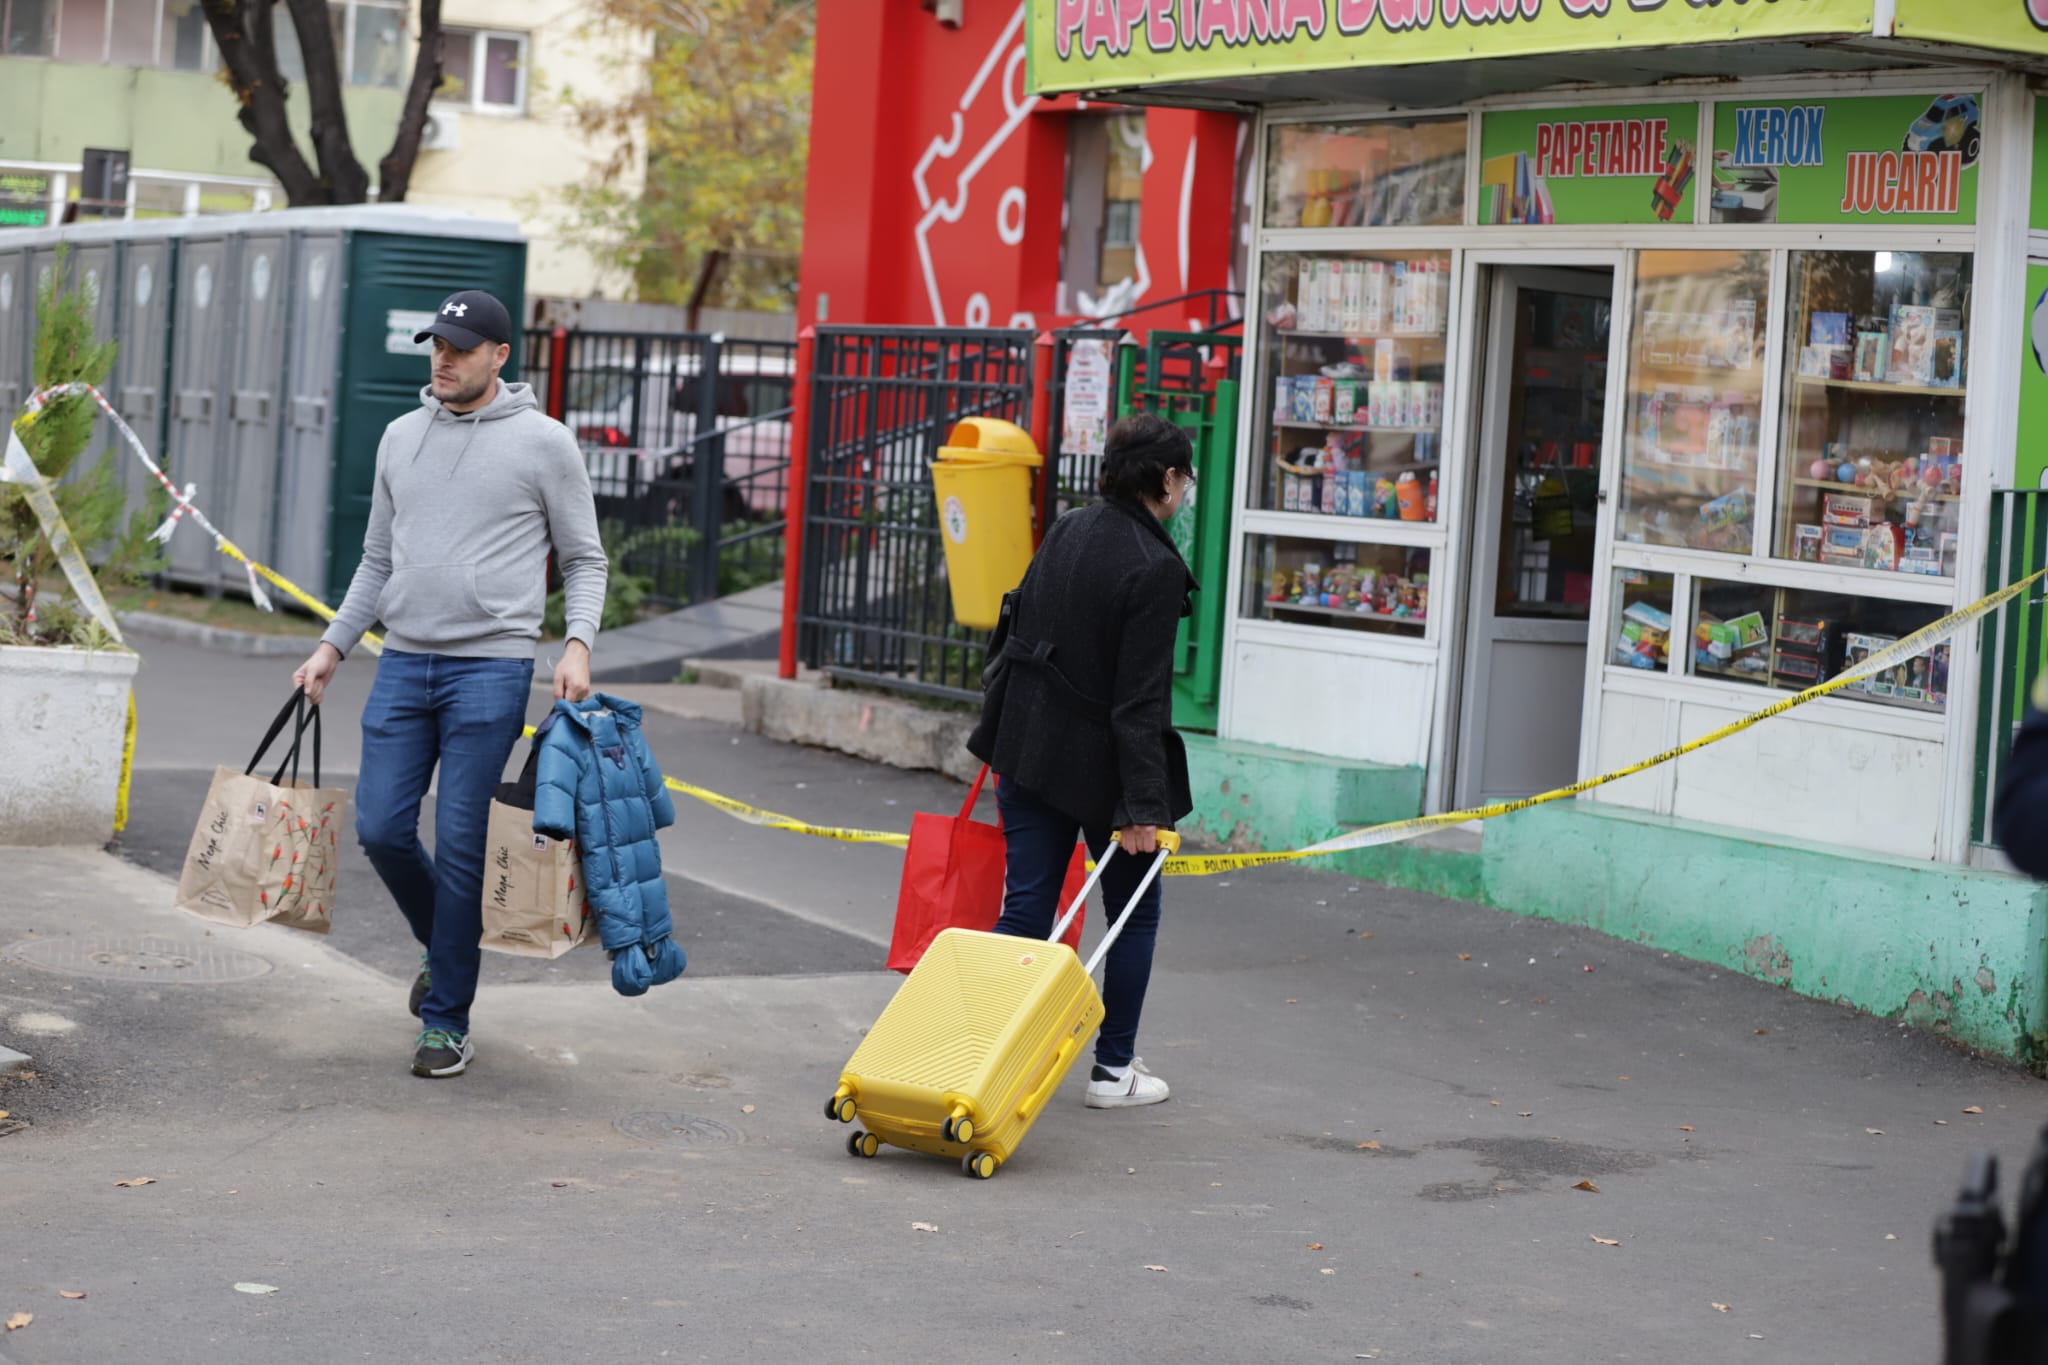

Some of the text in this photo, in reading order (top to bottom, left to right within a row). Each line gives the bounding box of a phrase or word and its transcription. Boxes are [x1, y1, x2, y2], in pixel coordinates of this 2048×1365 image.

[1535, 119, 1668, 177] PAPETARIE
[1733, 105, 1825, 167] XEROX
[1840, 151, 1962, 213] JUCARII
[197, 838, 222, 871] Mega
[211, 810, 229, 835] Chic
[1204, 858, 1240, 873] POLITIA
[494, 846, 515, 908] Mega Chic
